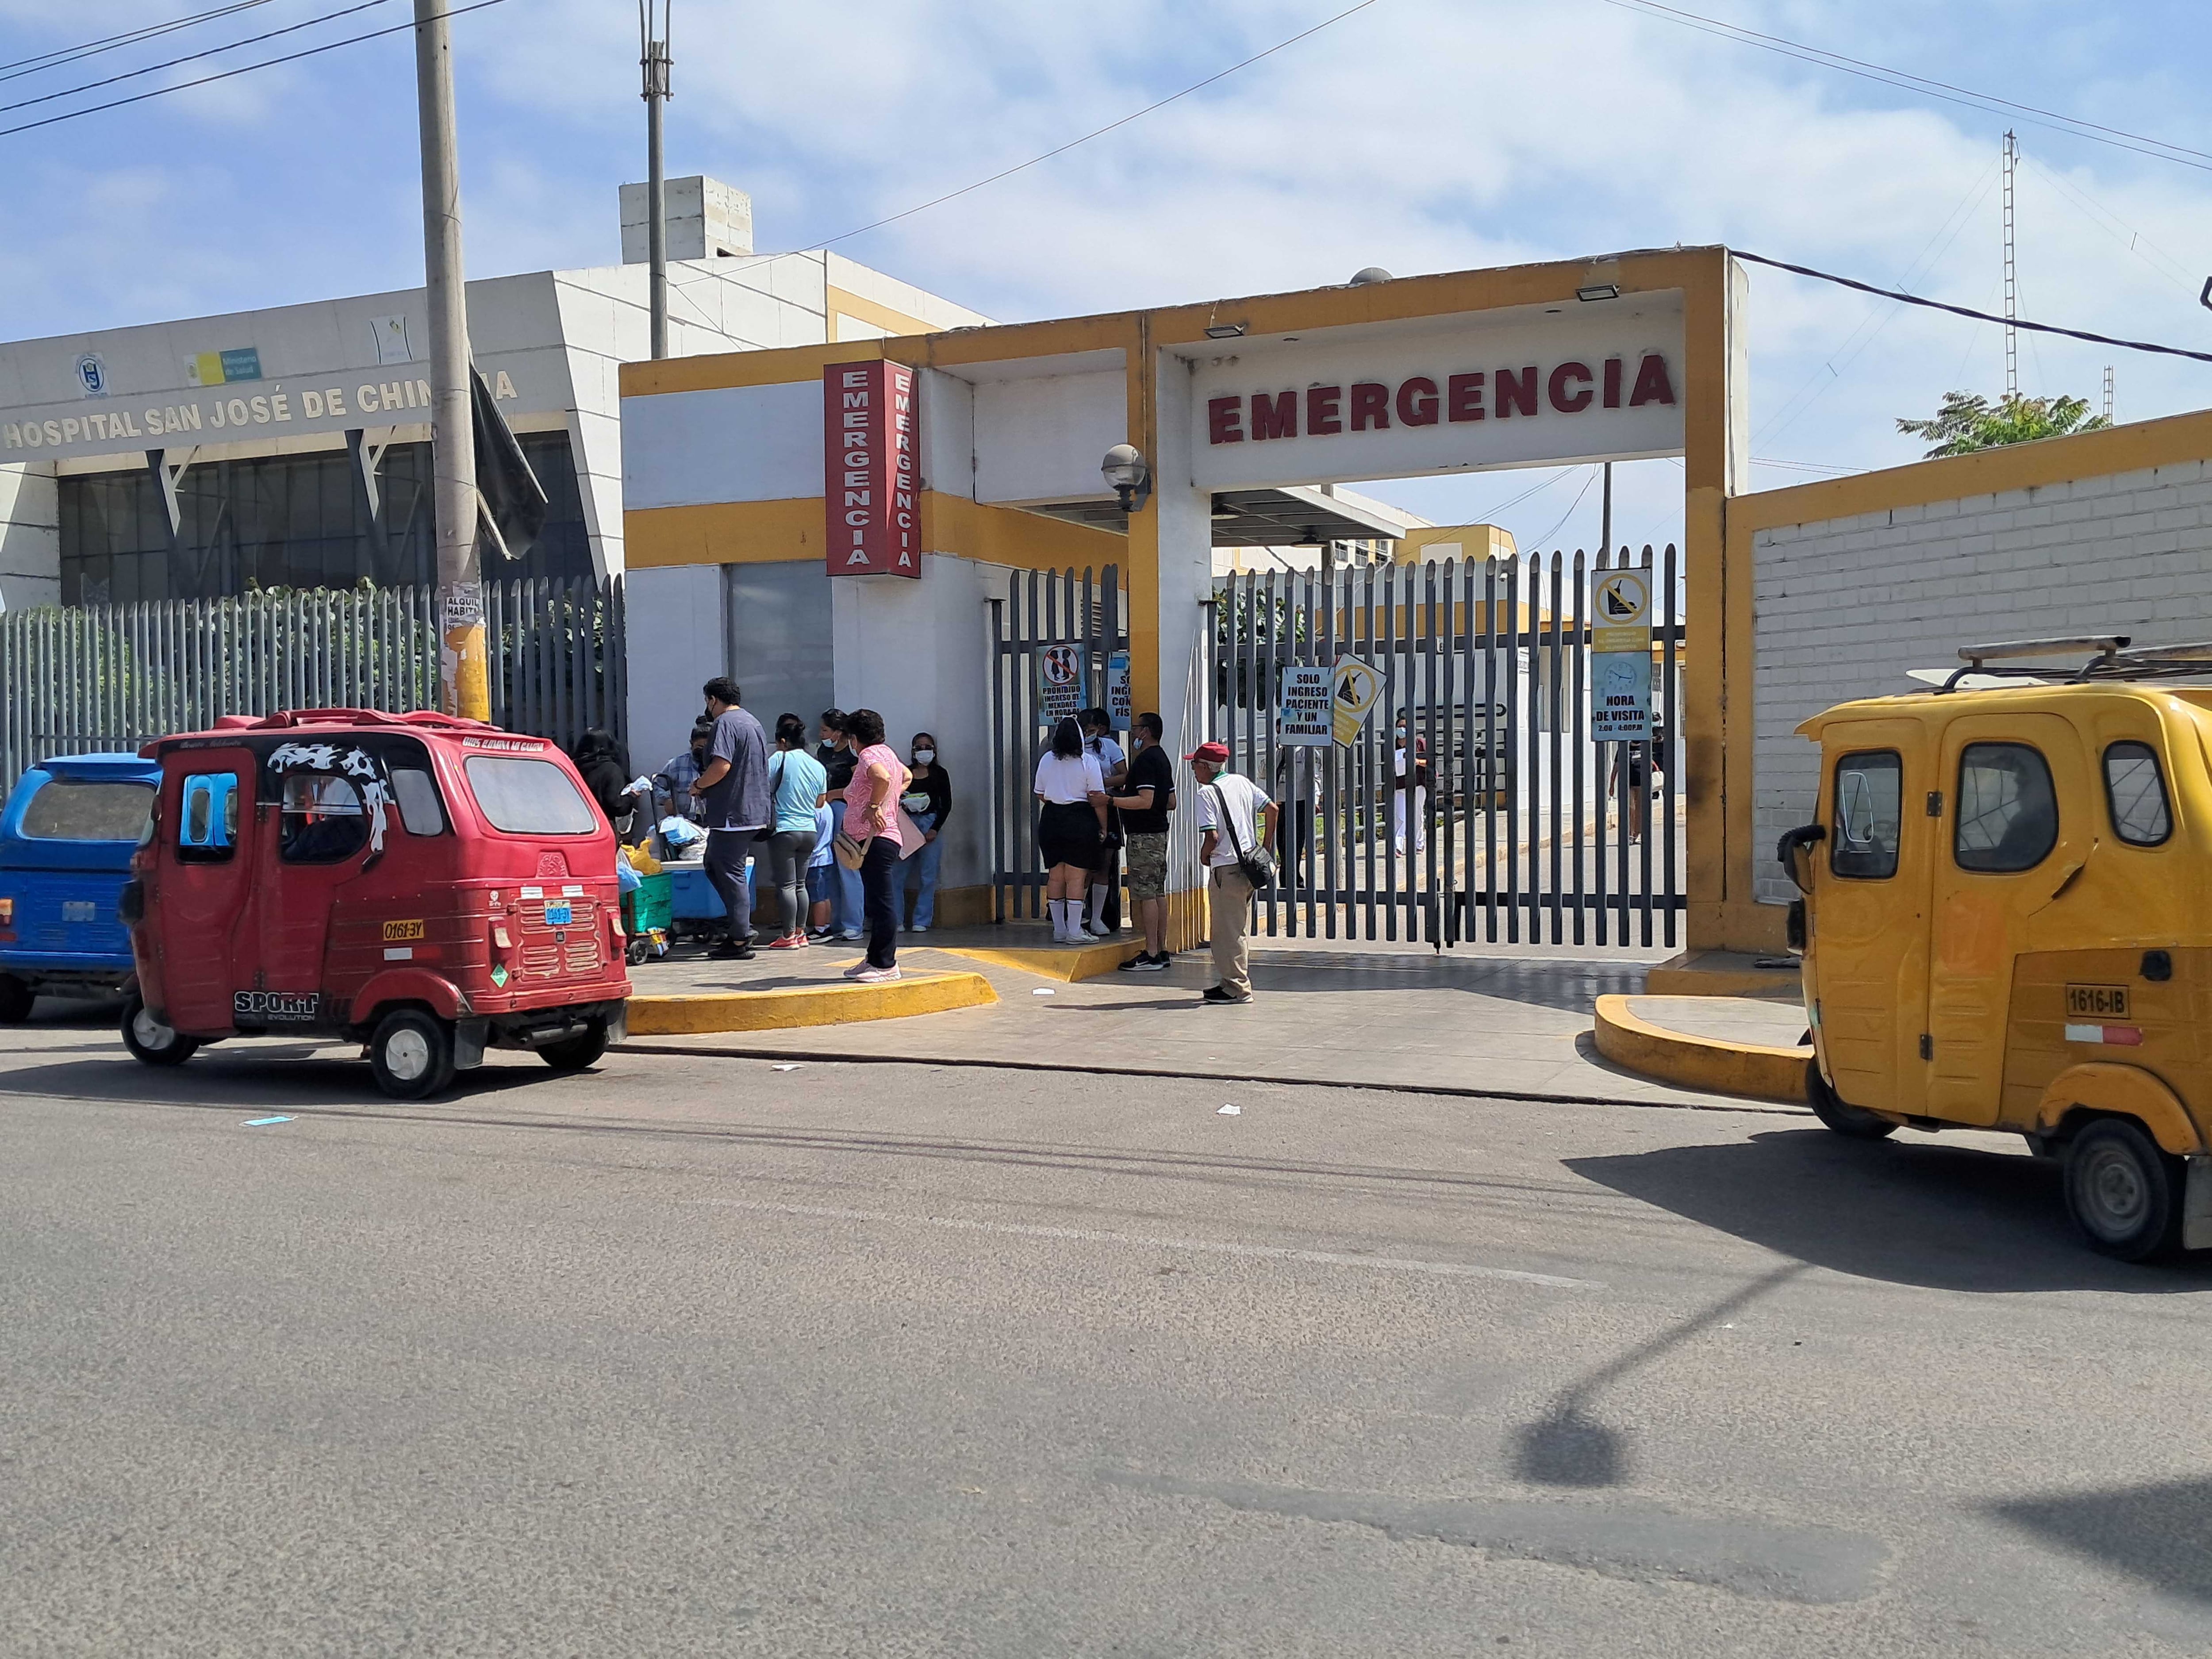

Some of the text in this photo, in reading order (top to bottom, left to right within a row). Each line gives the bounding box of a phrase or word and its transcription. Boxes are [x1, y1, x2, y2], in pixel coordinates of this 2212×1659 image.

[1208, 354, 1675, 445] EMERGENCIA
[3, 370, 518, 449] HOSPITAL SAN JOSÉ DE CHINA
[842, 370, 871, 565] EMERGENCIA
[895, 373, 911, 568] EMERGENCIA
[1297, 674, 1320, 684] SOLO
[1042, 685, 1081, 694] PROHIBIDO
[1288, 687, 1328, 697] INGRESO
[1286, 699, 1329, 710] PACIENTE
[1606, 695, 1635, 706] HORA
[1297, 712, 1317, 722] Y UN
[1596, 710, 1644, 721] DE VISITA
[1285, 724, 1327, 734] FAMILIAR
[385, 922, 422, 939] 0161-3Y
[234, 991, 319, 1014] SPORT
[2070, 990, 2124, 1013] 1616-IB
